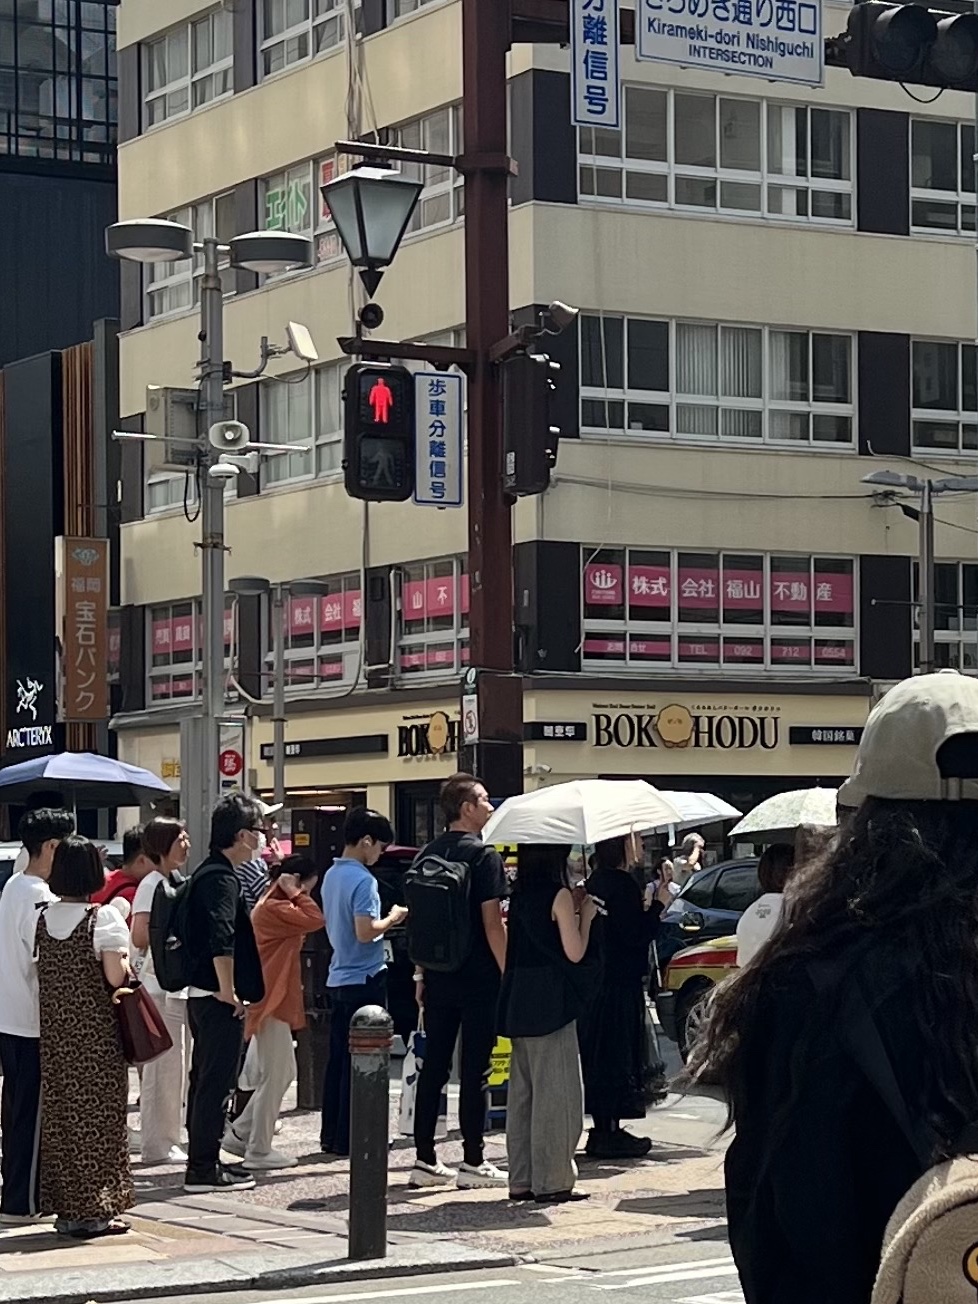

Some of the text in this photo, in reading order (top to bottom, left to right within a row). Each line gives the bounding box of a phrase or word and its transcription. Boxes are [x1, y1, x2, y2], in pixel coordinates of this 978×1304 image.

[647, 17, 814, 59] Kirameki-dori Nishiguchi
[689, 45, 773, 69] INTERSECTION
[428, 378, 447, 499] 歩車分離信号
[71, 576, 101, 594] 福岡
[75, 600, 98, 712] 宝石バンク
[690, 644, 708, 655] TEL
[592, 713, 780, 750] BOK HODU
